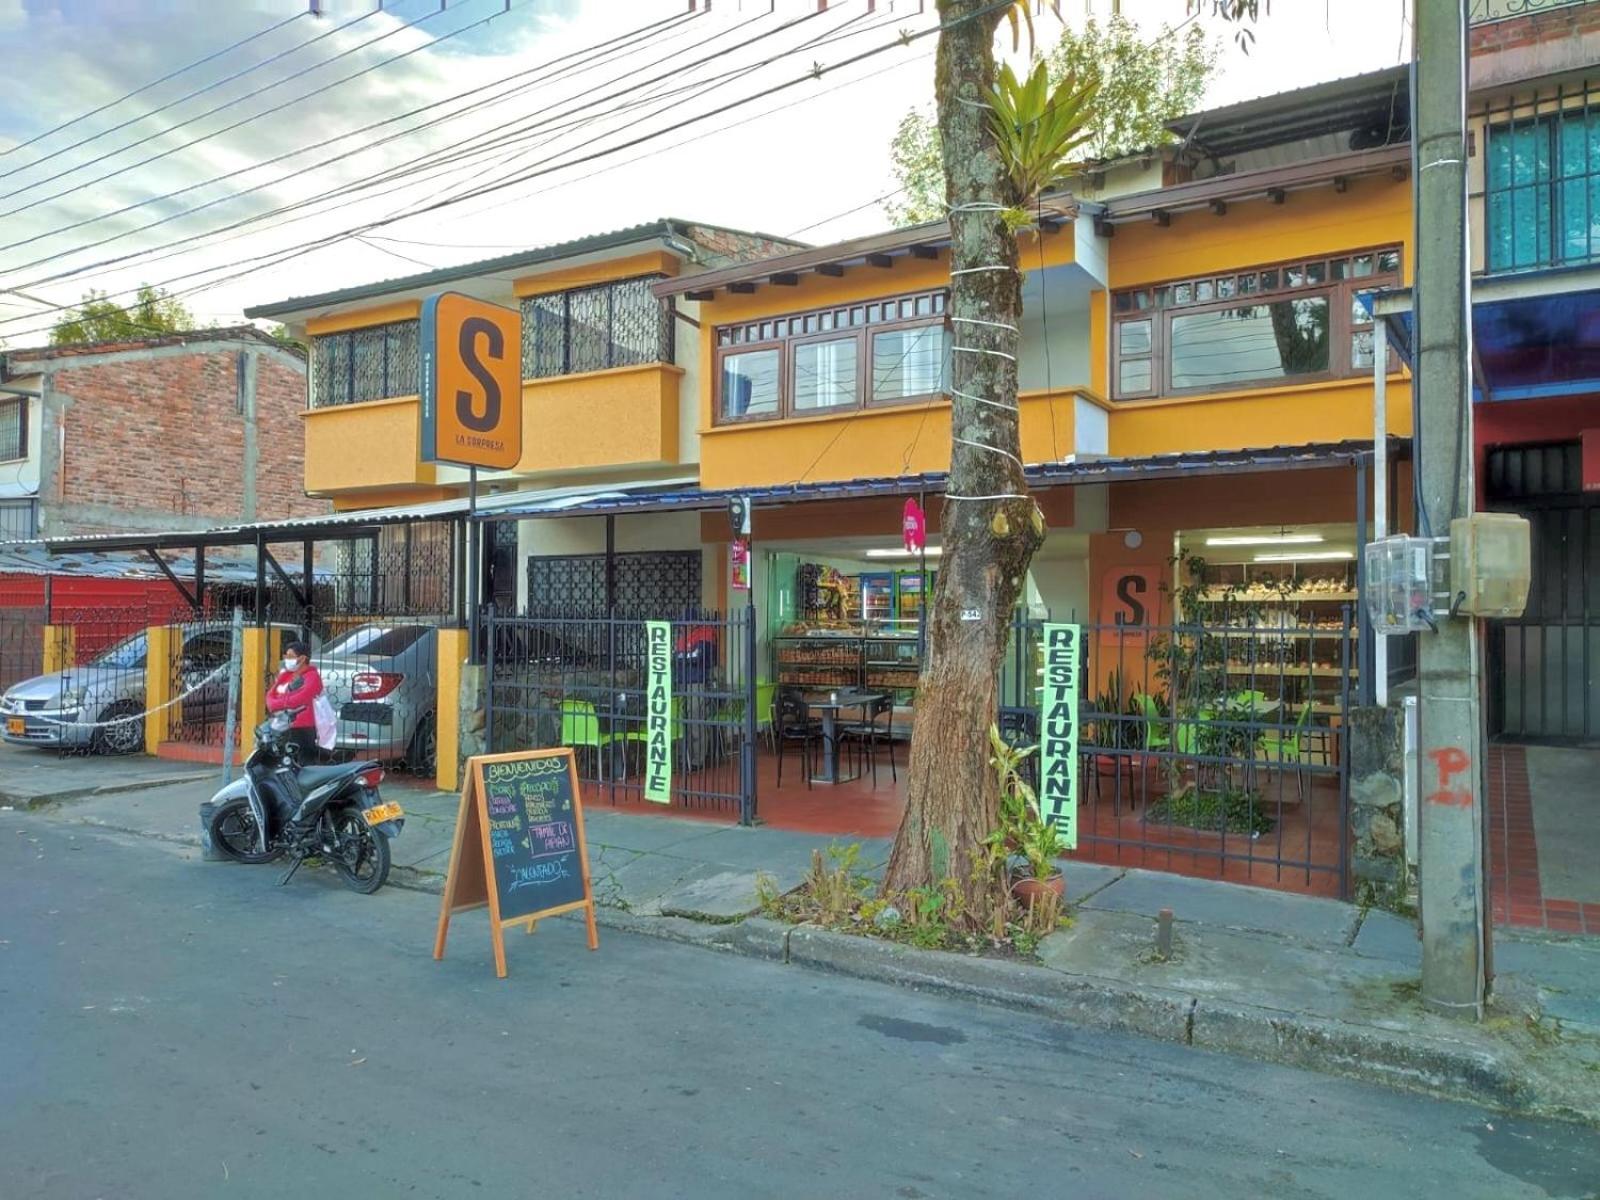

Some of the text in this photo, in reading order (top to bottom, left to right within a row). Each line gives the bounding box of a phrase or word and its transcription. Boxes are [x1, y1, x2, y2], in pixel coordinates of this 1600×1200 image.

[455, 316, 505, 433] S
[455, 434, 505, 452] LA SORPRESA
[1114, 575, 1147, 628] S
[649, 626, 668, 793] RESTAURANTE
[1045, 628, 1075, 835] RESTAURANTE
[488, 758, 561, 779] BIENVENIDOS
